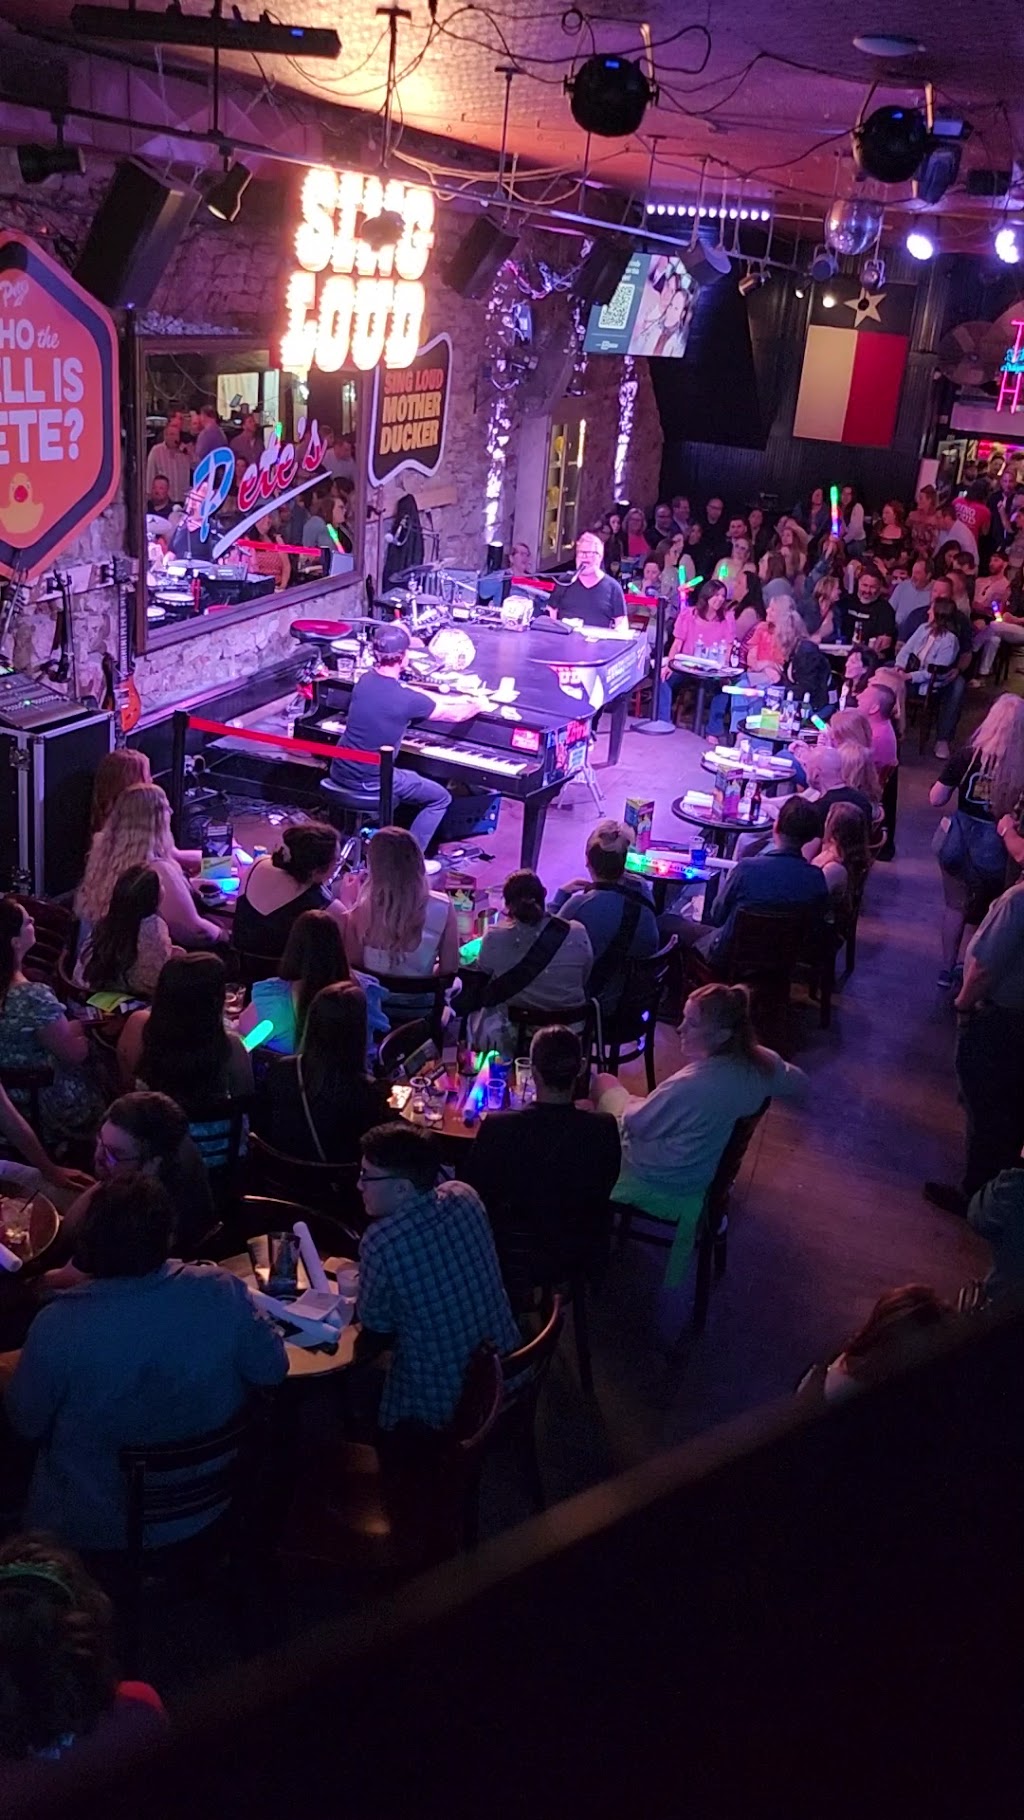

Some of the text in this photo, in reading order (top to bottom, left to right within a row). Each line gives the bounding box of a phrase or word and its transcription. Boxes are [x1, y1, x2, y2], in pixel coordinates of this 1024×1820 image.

[293, 164, 435, 281] SING
[0, 318, 60, 350] HO the
[279, 270, 426, 373] LOUD
[53, 357, 85, 404] IS
[383, 368, 444, 395] SING LOUD
[382, 391, 442, 424] MOTHER
[379, 419, 439, 455] DUCKER
[193, 416, 328, 543] Pete's
